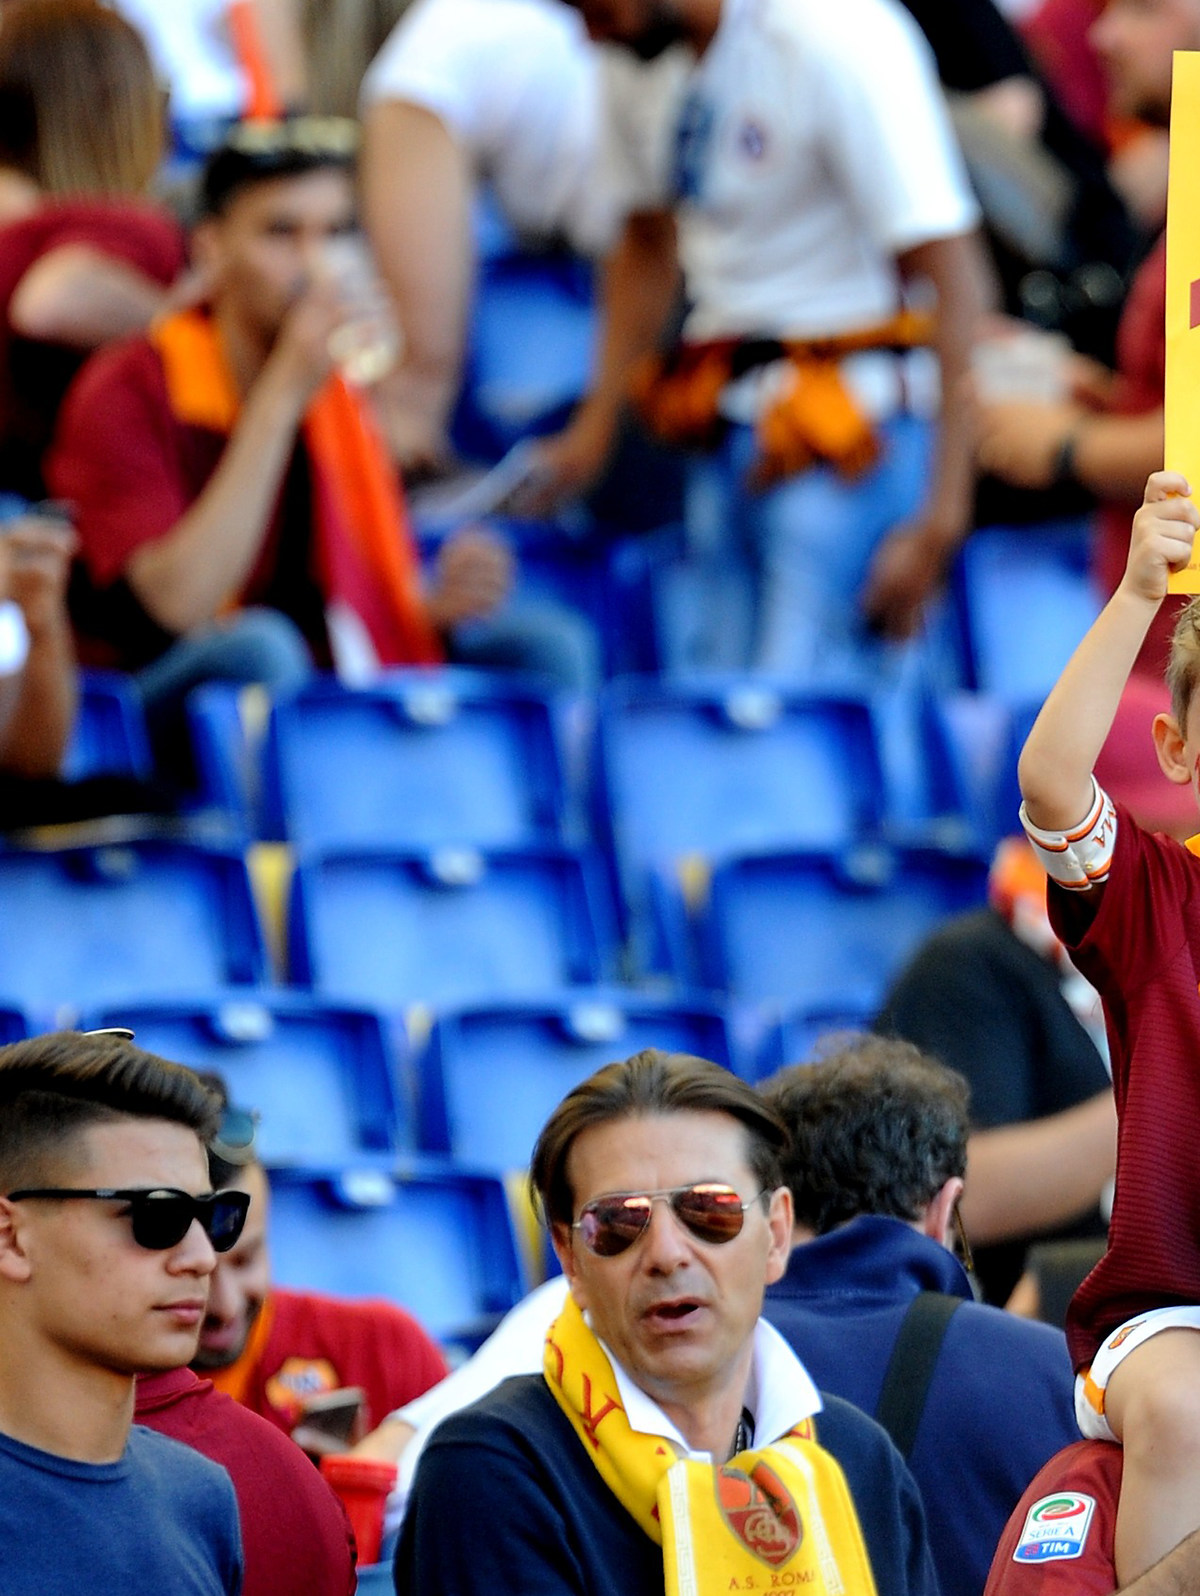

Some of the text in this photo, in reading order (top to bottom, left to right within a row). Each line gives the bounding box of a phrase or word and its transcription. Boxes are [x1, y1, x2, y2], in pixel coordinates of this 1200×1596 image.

[1029, 1526, 1074, 1539] SERIE A
[1041, 1541, 1070, 1554] TIM
[728, 1575, 759, 1590] A.S.
